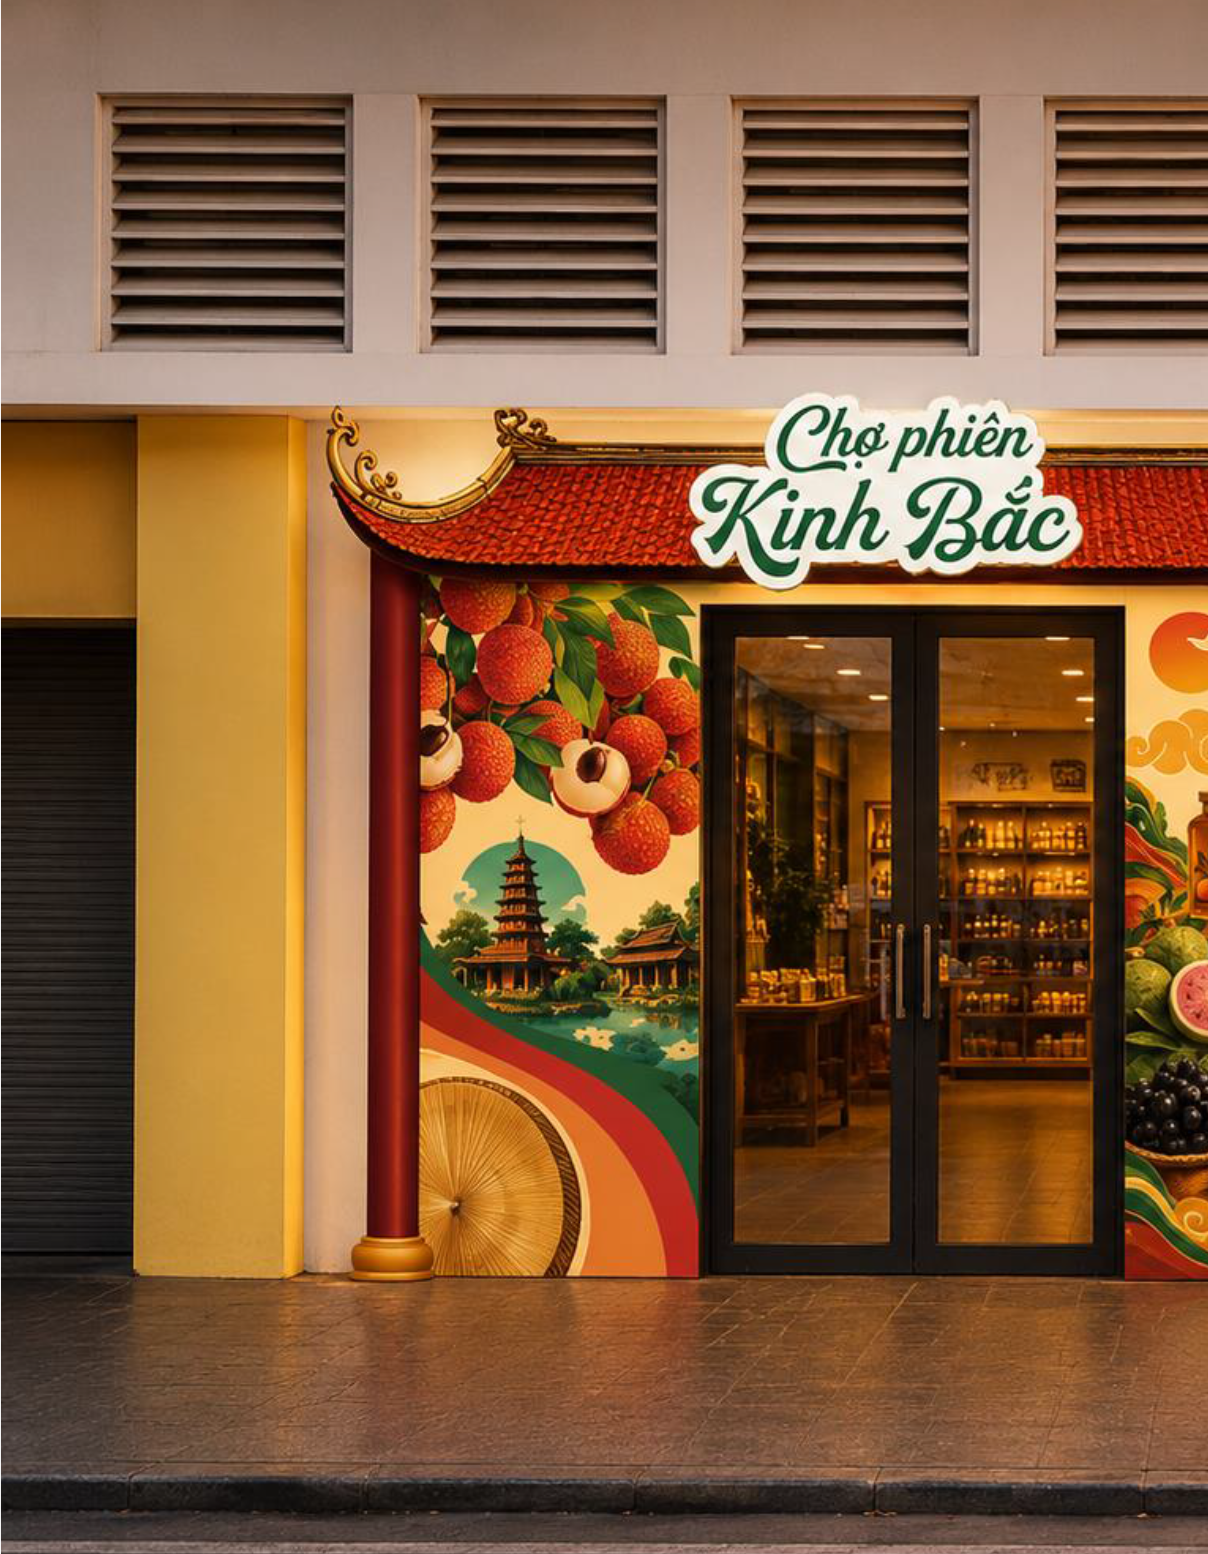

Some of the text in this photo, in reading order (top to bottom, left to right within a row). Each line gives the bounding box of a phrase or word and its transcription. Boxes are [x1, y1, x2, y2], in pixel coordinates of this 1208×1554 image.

[776, 404, 1034, 473] Chợ phiên
[701, 475, 1070, 577] Kinh Bắc
